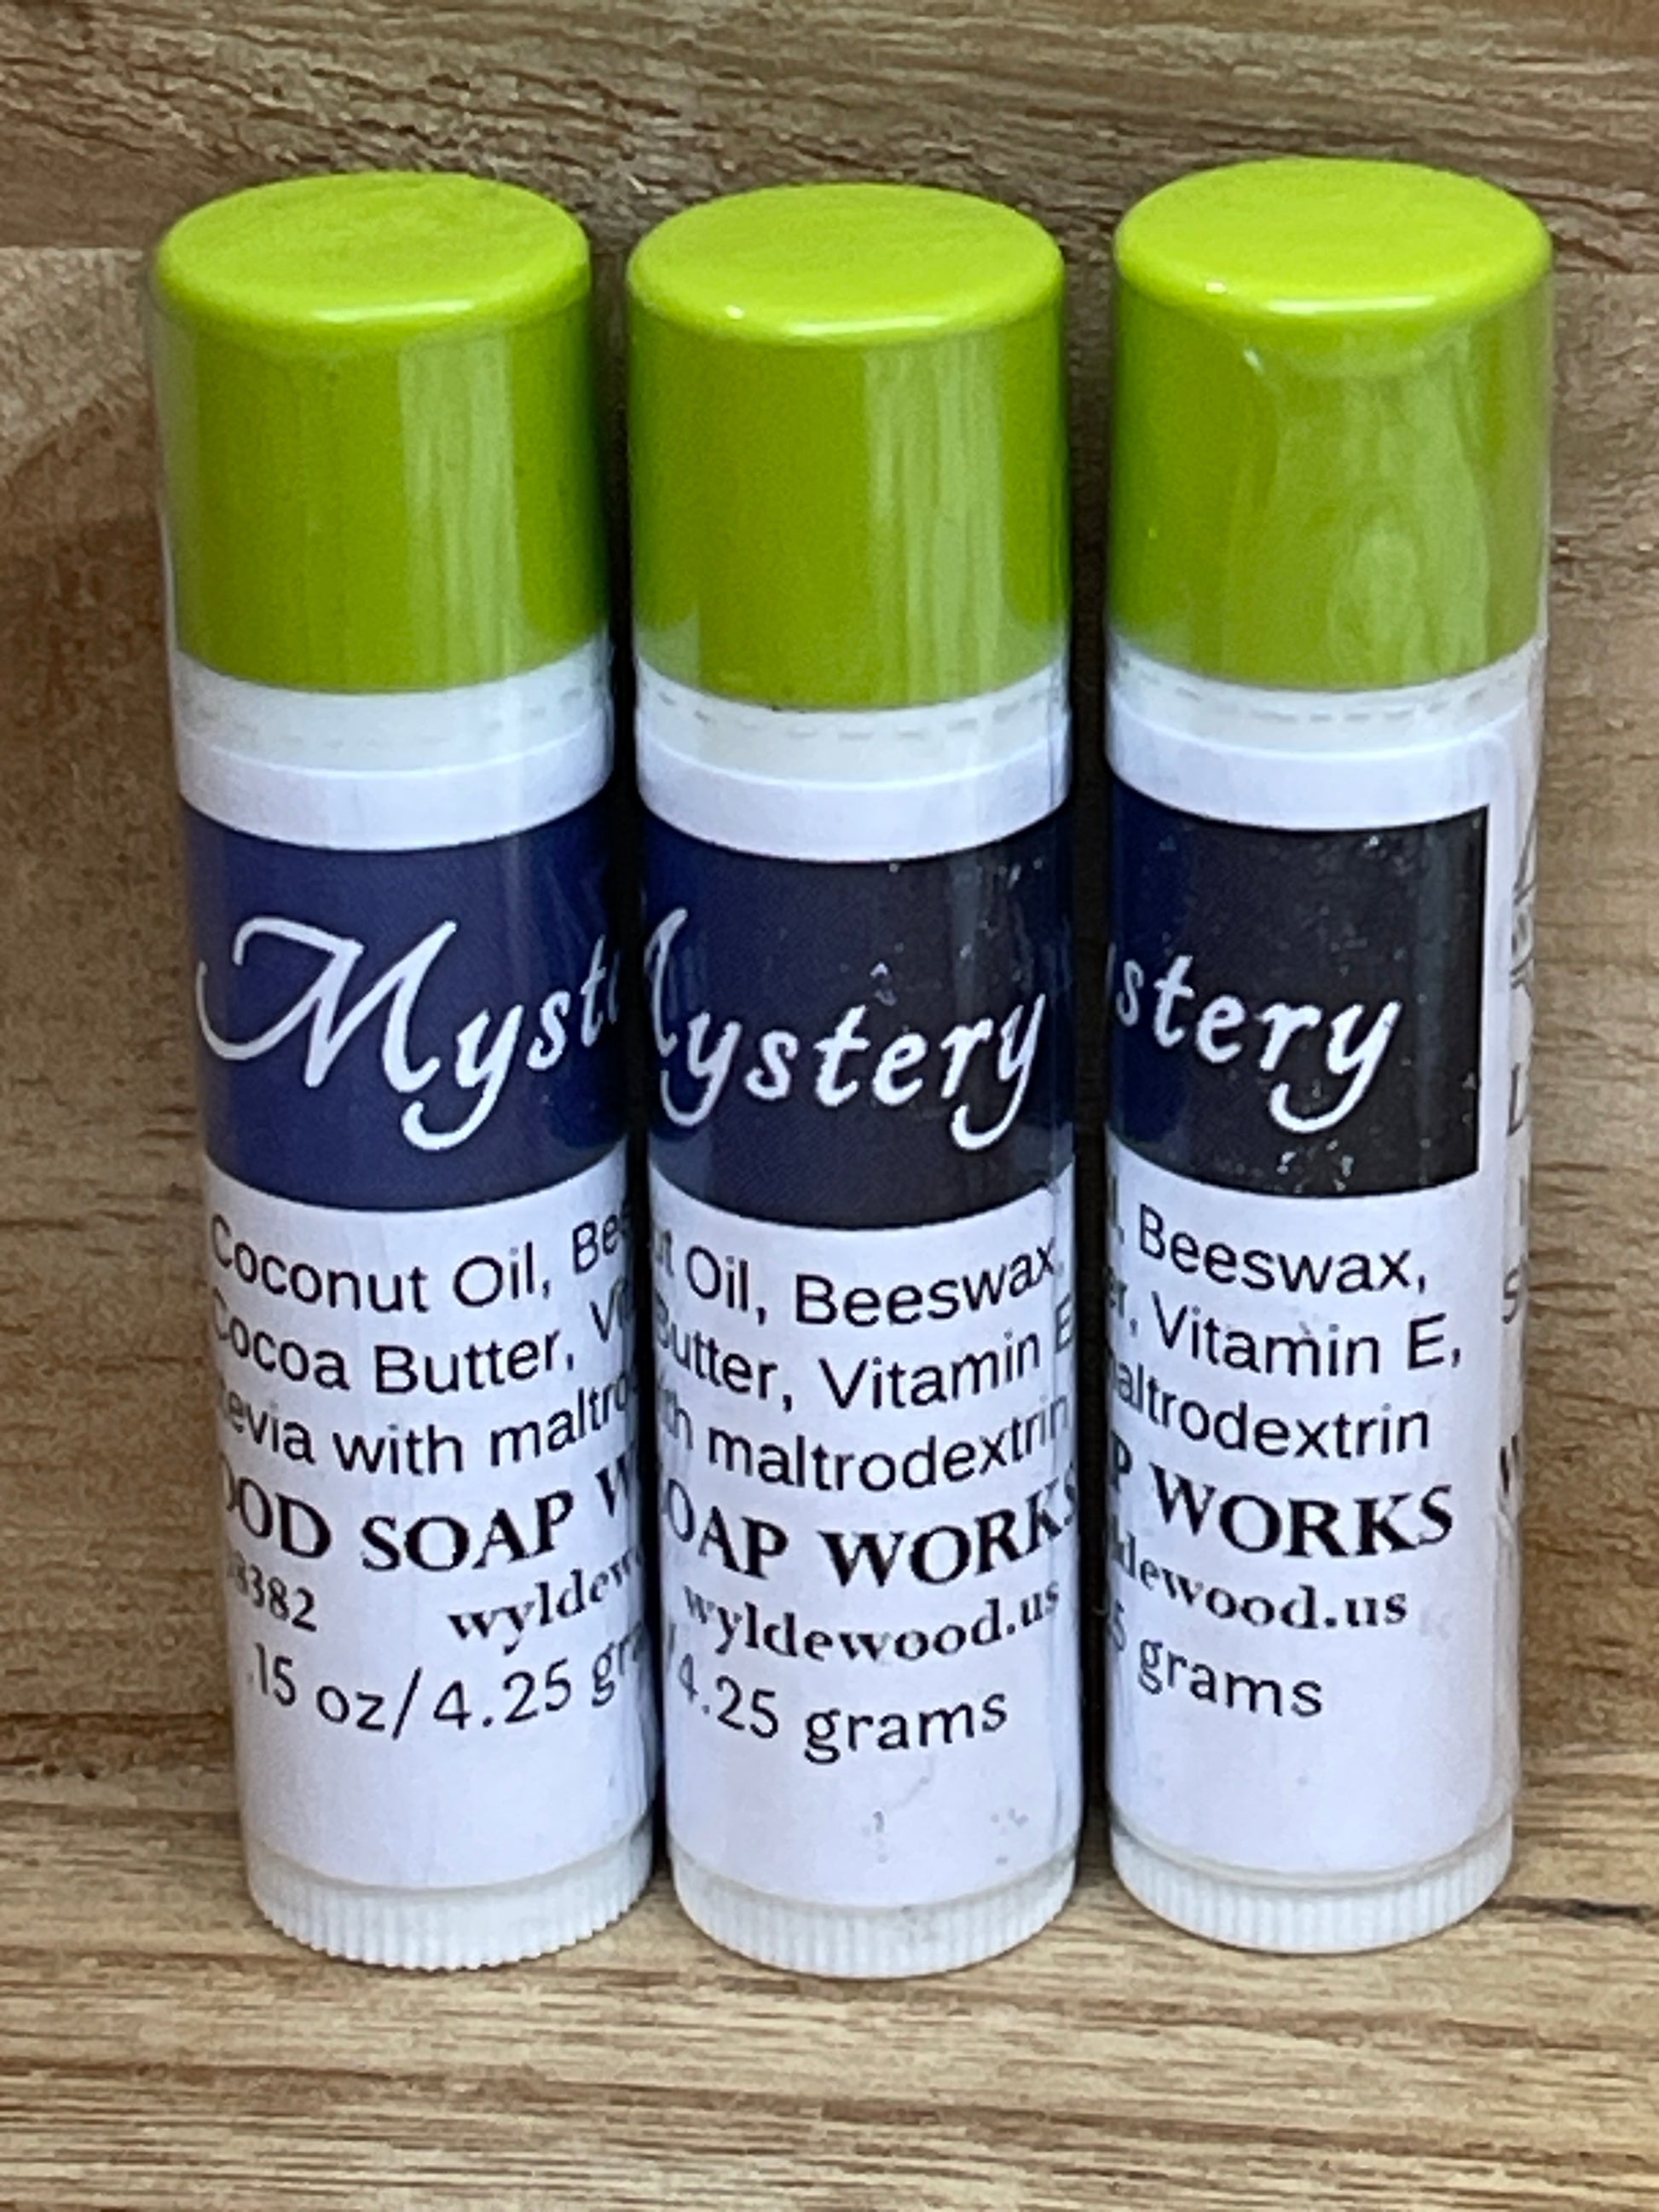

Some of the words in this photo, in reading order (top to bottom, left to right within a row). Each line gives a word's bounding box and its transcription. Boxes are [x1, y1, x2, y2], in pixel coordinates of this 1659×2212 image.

[195, 917, 621, 1151] Myst
[1105, 942, 1402, 1134] stery
[211, 1214, 429, 1314] Coconut
[452, 1241, 552, 1308] Oil,
[685, 1245, 767, 1325] Oil,
[1139, 1203, 1426, 1295] Beeswax,
[213, 1287, 350, 1391] Cocoa
[373, 1329, 575, 1395] Butter,
[818, 1327, 1040, 1410] Vitamin
[1151, 1291, 1380, 1377] Vitamin
[1407, 1313, 1461, 1370] E,
[220, 1377, 315, 1465] evia
[332, 1424, 463, 1476] with
[490, 1370, 629, 1466] maltro
[708, 1394, 1068, 1493] maltrodextrin
[1110, 1360, 1429, 1460] altrodextrin
[360, 1489, 575, 1573] SOAP
[1148, 1461, 1453, 1559] WORKS
[683, 1580, 1060, 1661] wyldewood.us
[316, 1649, 573, 1740] oz/4.25
[1137, 1638, 1323, 1718] grams
[803, 1692, 1009, 1765] grams
